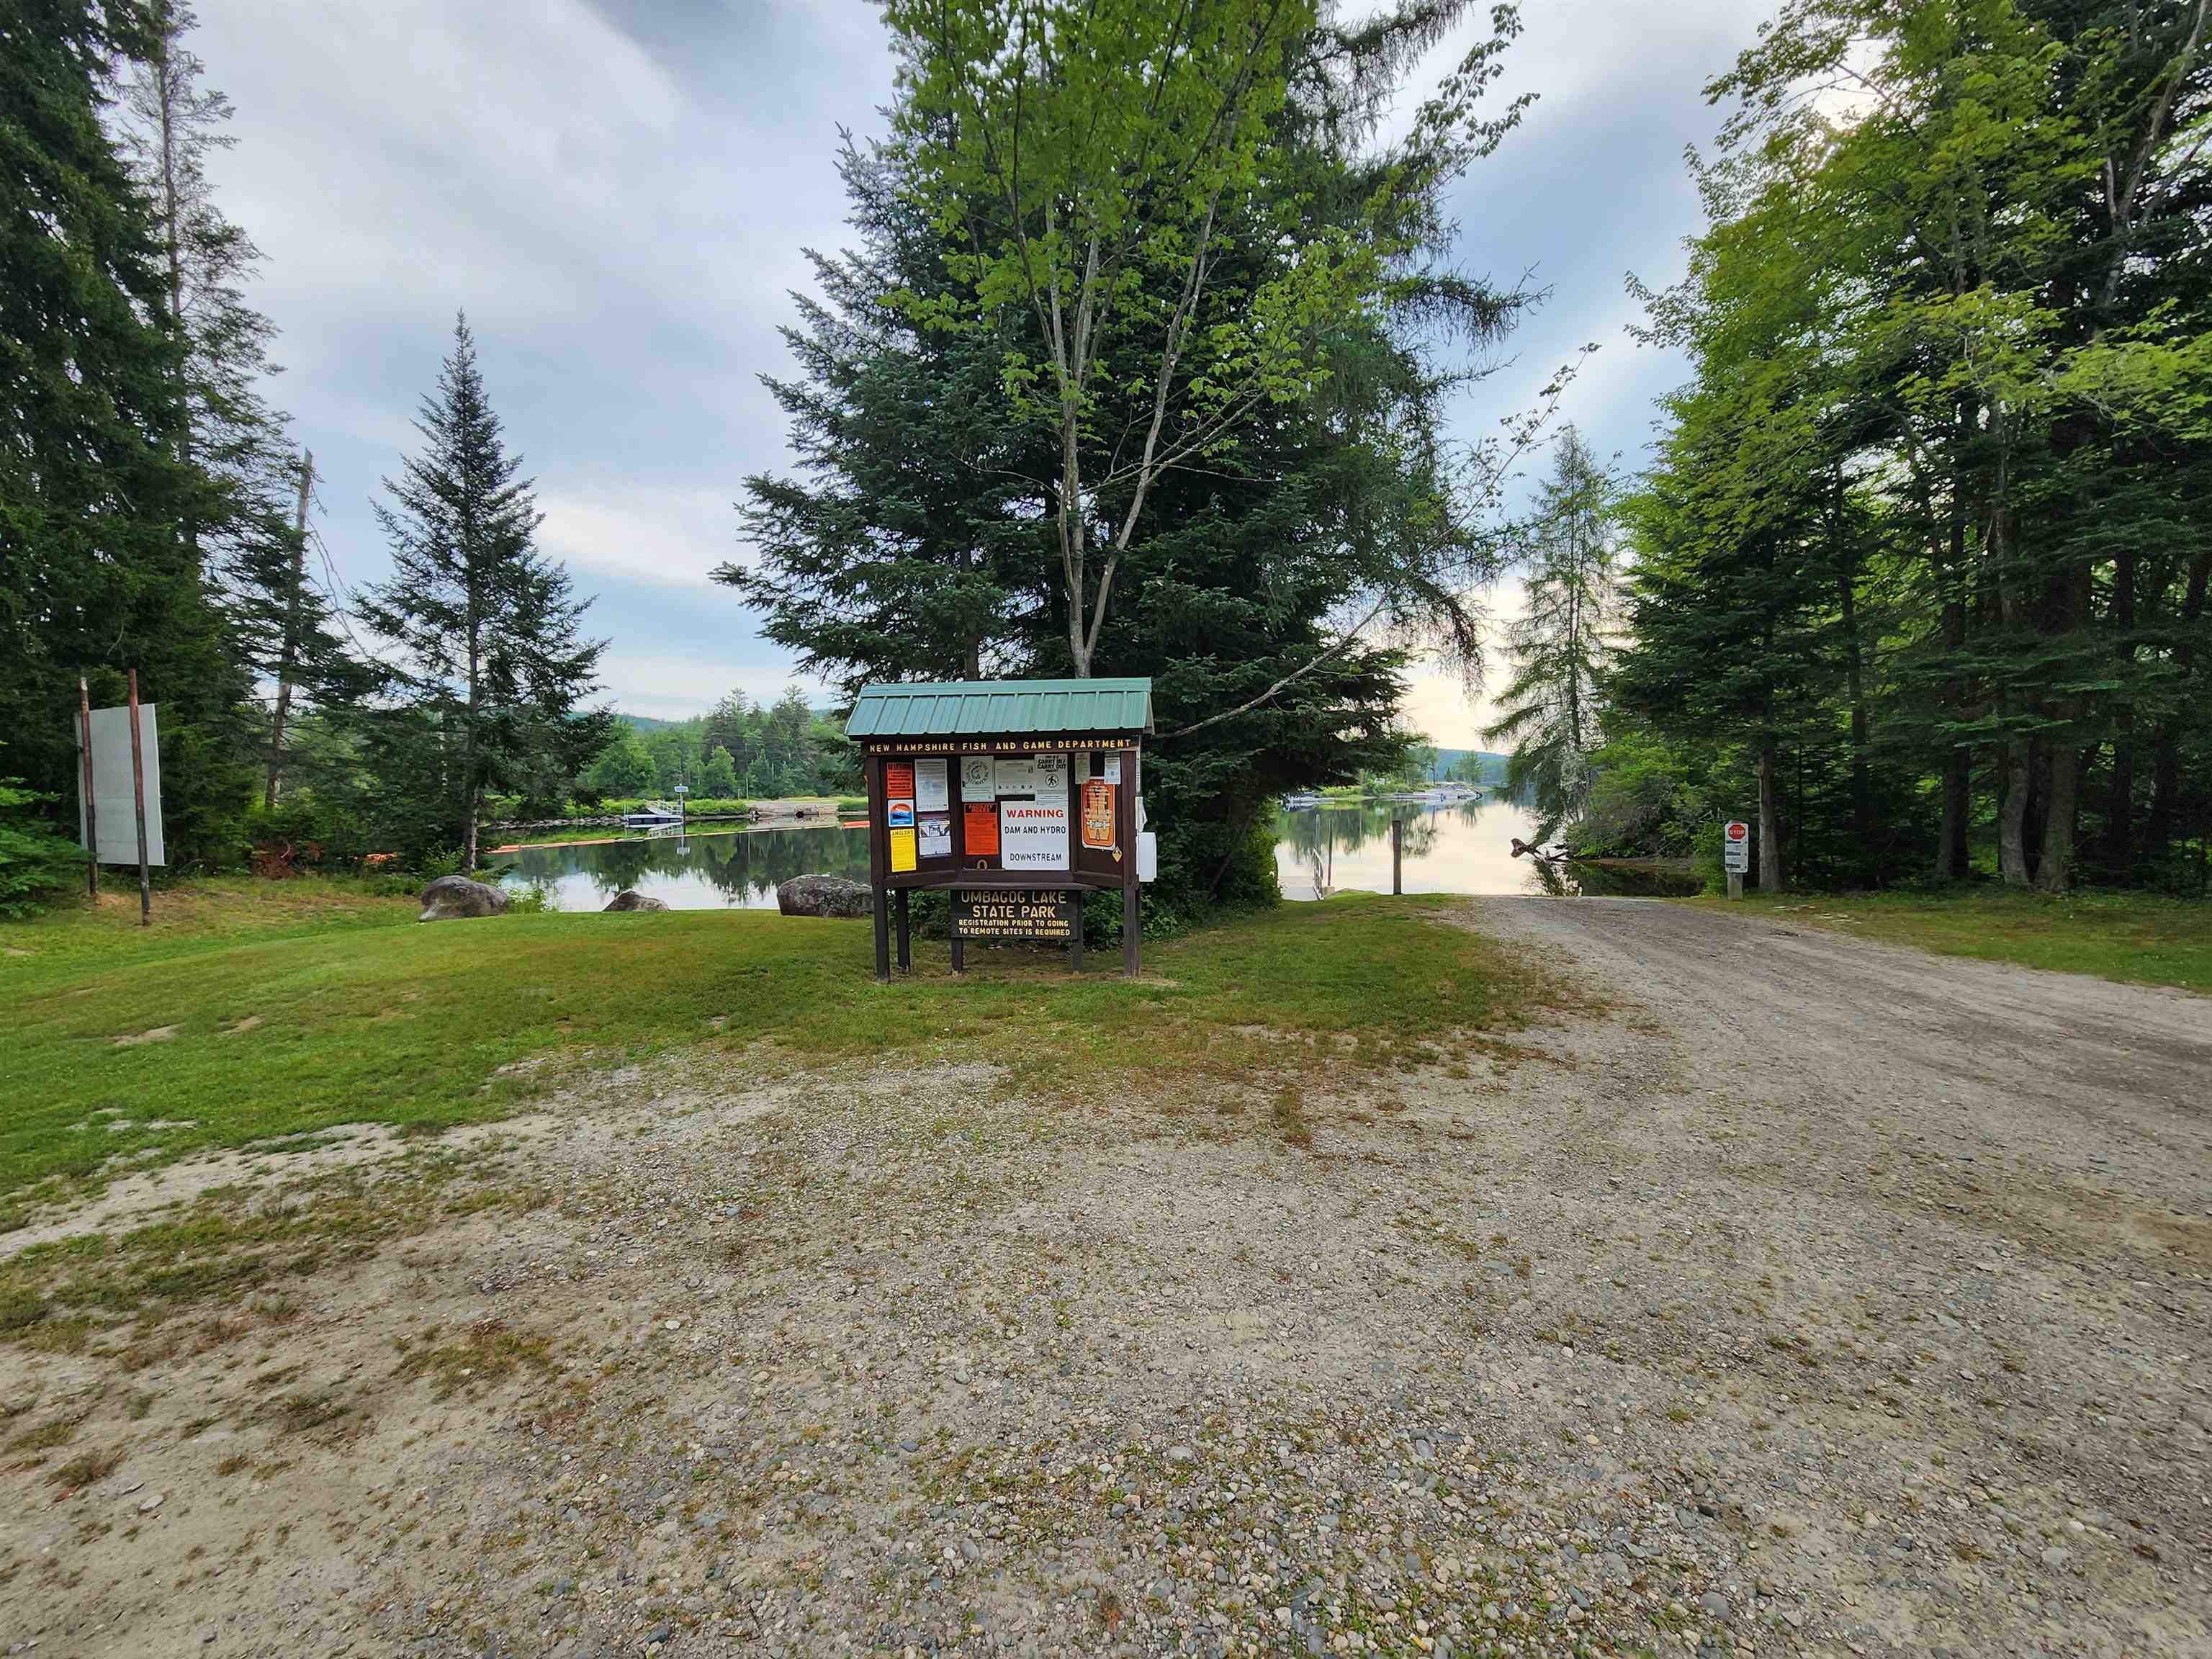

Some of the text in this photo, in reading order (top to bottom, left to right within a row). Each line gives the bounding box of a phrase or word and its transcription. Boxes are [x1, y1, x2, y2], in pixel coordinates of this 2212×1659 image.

[869, 744, 890, 752] NEW
[896, 743, 955, 752] HAMPSHIRE
[1058, 739, 1130, 749] DEPARTMENT
[1006, 809, 1064, 818] WARNING
[1010, 853, 1061, 861] DOWNSTREAM
[961, 891, 1066, 904] UMBAGOG LAKE
[973, 905, 1056, 918] STATE PARK
